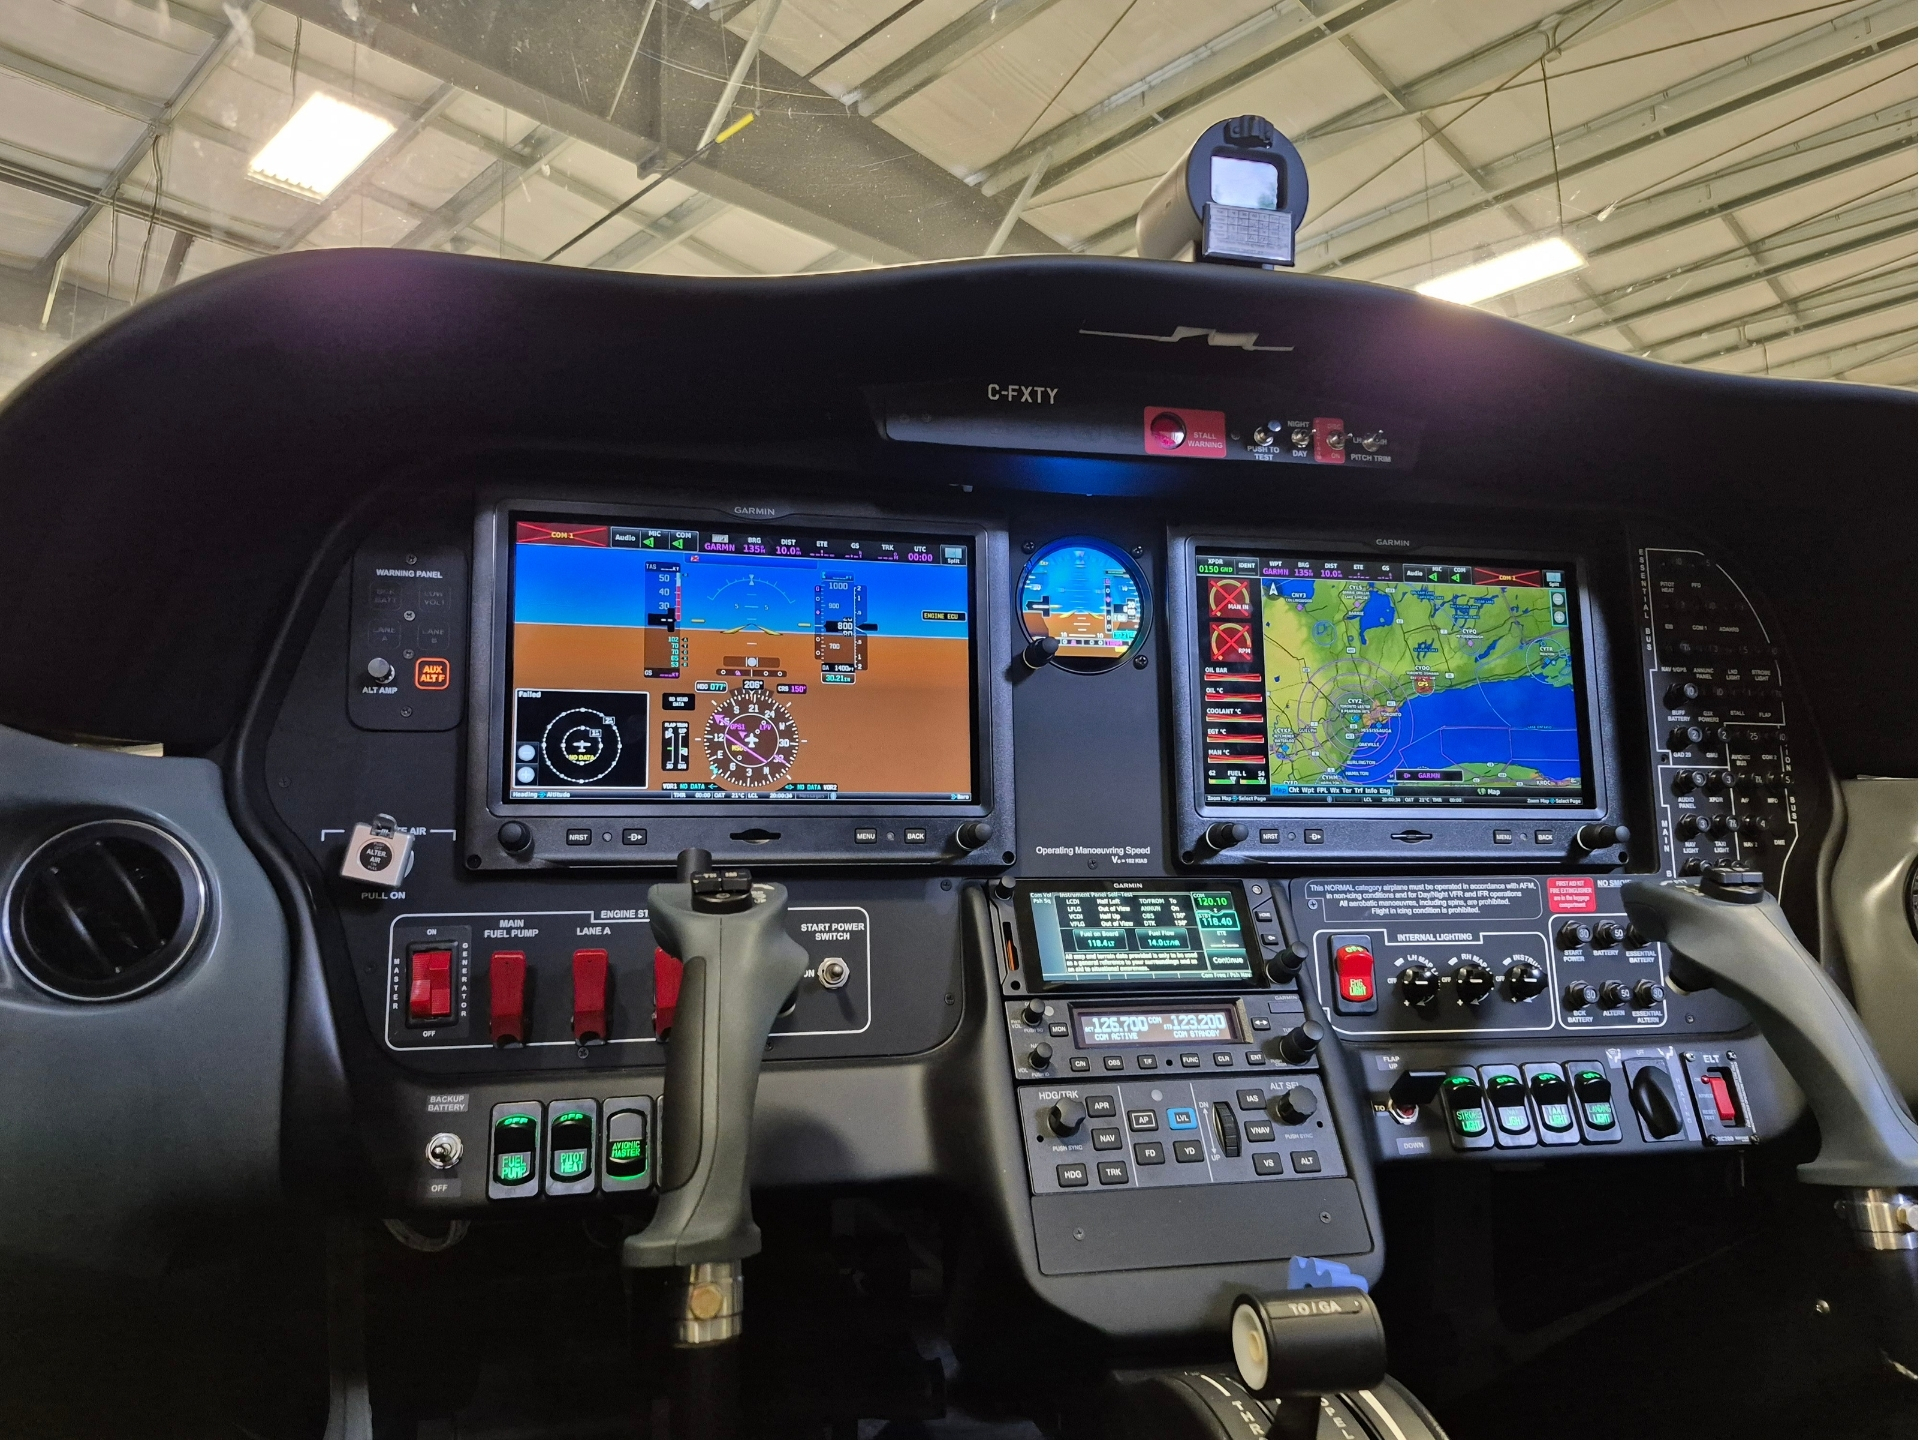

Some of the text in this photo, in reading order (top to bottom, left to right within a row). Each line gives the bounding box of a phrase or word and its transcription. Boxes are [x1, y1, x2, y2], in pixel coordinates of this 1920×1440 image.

[988, 383, 1059, 404] C-FXTY
[1188, 440, 1223, 449] WARNING
[734, 506, 775, 516] GARMIN
[1376, 538, 1410, 547] GARMIN
[705, 543, 933, 562] GARMN 00:00
[376, 569, 414, 577] WARNING
[829, 582, 848, 590] 1000
[659, 588, 669, 596] 40
[423, 665, 442, 673] AUX
[410, 827, 426, 835] AIR
[1036, 847, 1150, 856] Operating Manoeuvring Speed
[1334, 892, 1361, 900] non-icing
[1418, 891, 1448, 899] Day/Night
[601, 910, 635, 918] ENGINE
[577, 927, 601, 935] LANE
[832, 923, 864, 931] POWER
[484, 929, 538, 938] FUEL PUMP
[1092, 1015, 1226, 1032] 126.700 123.200
[1703, 1055, 1719, 1063] ELT
[1270, 1082, 1284, 1090] ALT
[1039, 1091, 1078, 1100] HDG/TRK
[428, 1103, 465, 1111] BATTERY
[1457, 1111, 1482, 1120] STROBE
[612, 1141, 640, 1149] AVIONIC
[561, 1152, 584, 1162] PITOT
[612, 1149, 640, 1157] MASTER
[502, 1156, 525, 1168] FUEL
[561, 1162, 582, 1172] HEAT
[502, 1167, 526, 1179] PUMP
[431, 1184, 447, 1192] OFF
